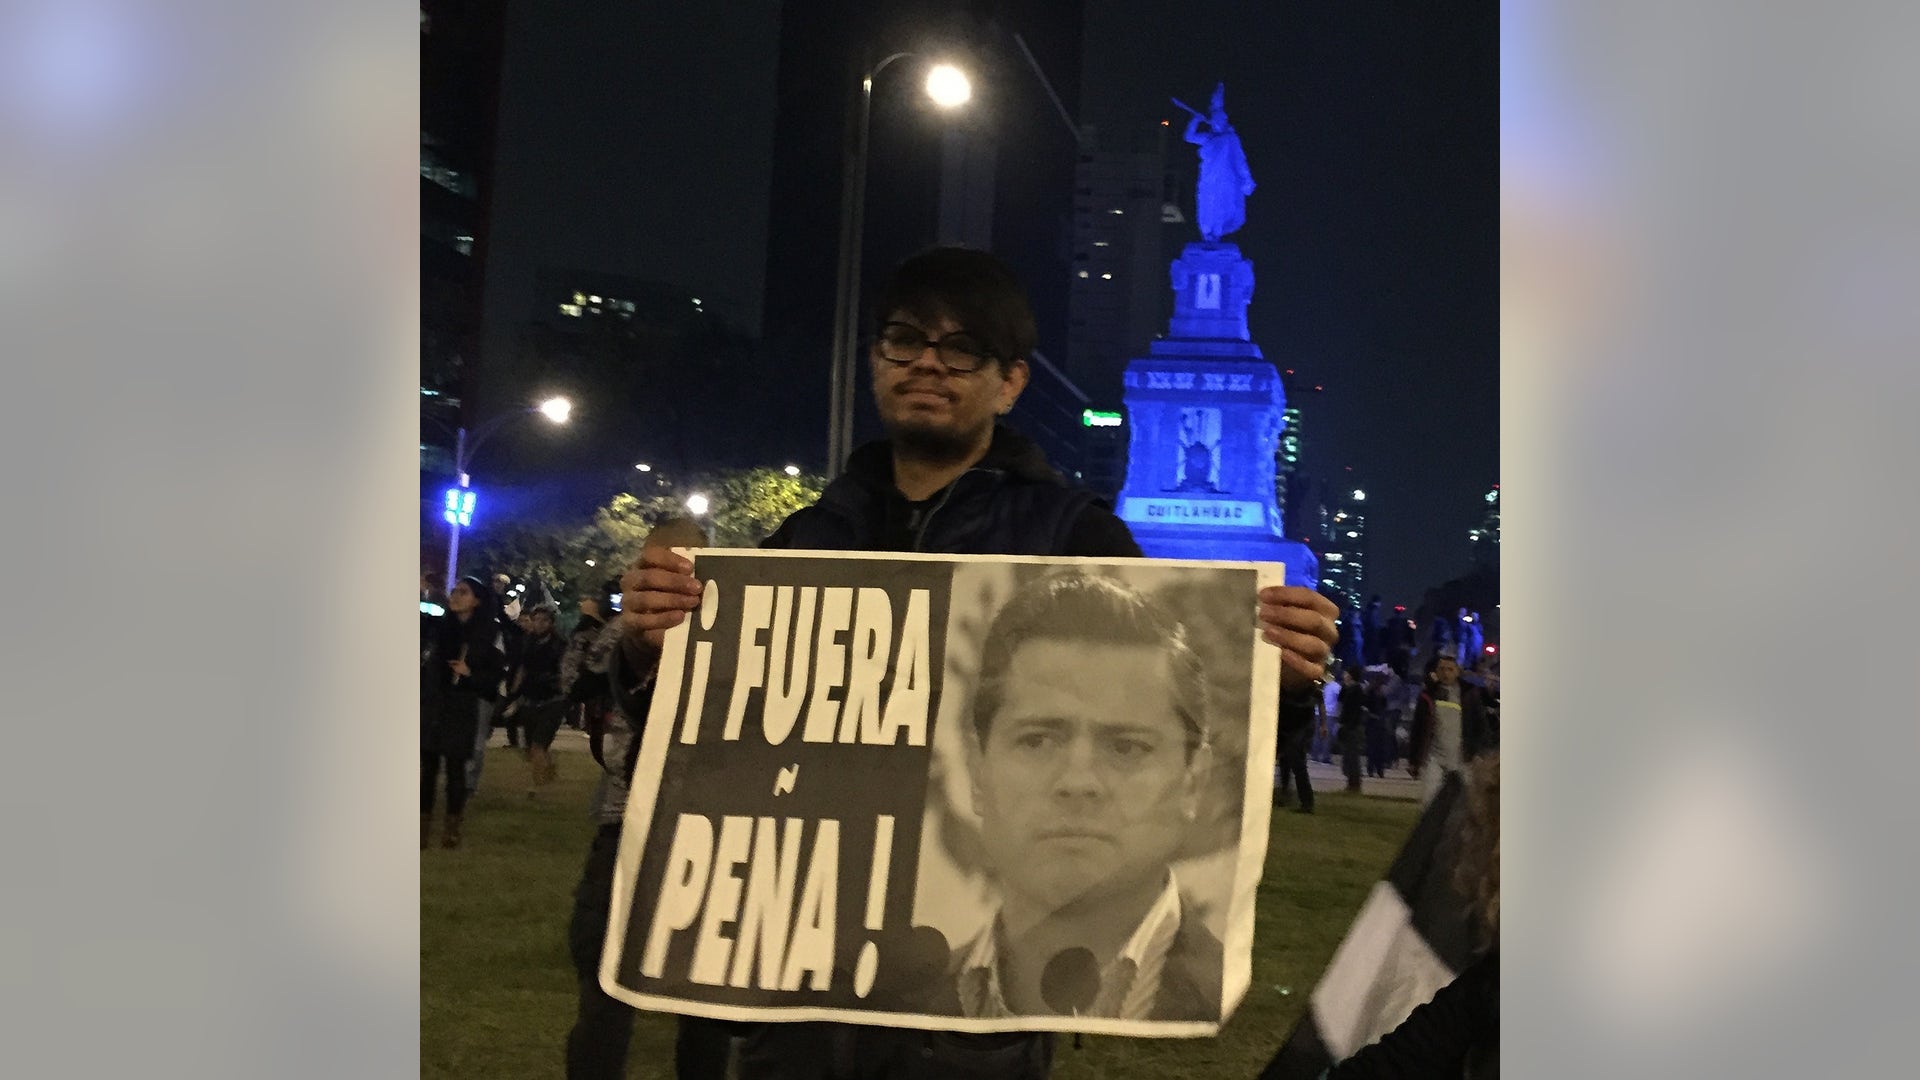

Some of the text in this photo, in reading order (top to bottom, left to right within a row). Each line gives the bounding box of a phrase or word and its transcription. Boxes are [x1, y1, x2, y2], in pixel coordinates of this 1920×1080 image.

[1147, 504, 1243, 519] CUITLAHUAC
[722, 584, 931, 747] FUERA
[639, 763, 840, 992] PEÑA
